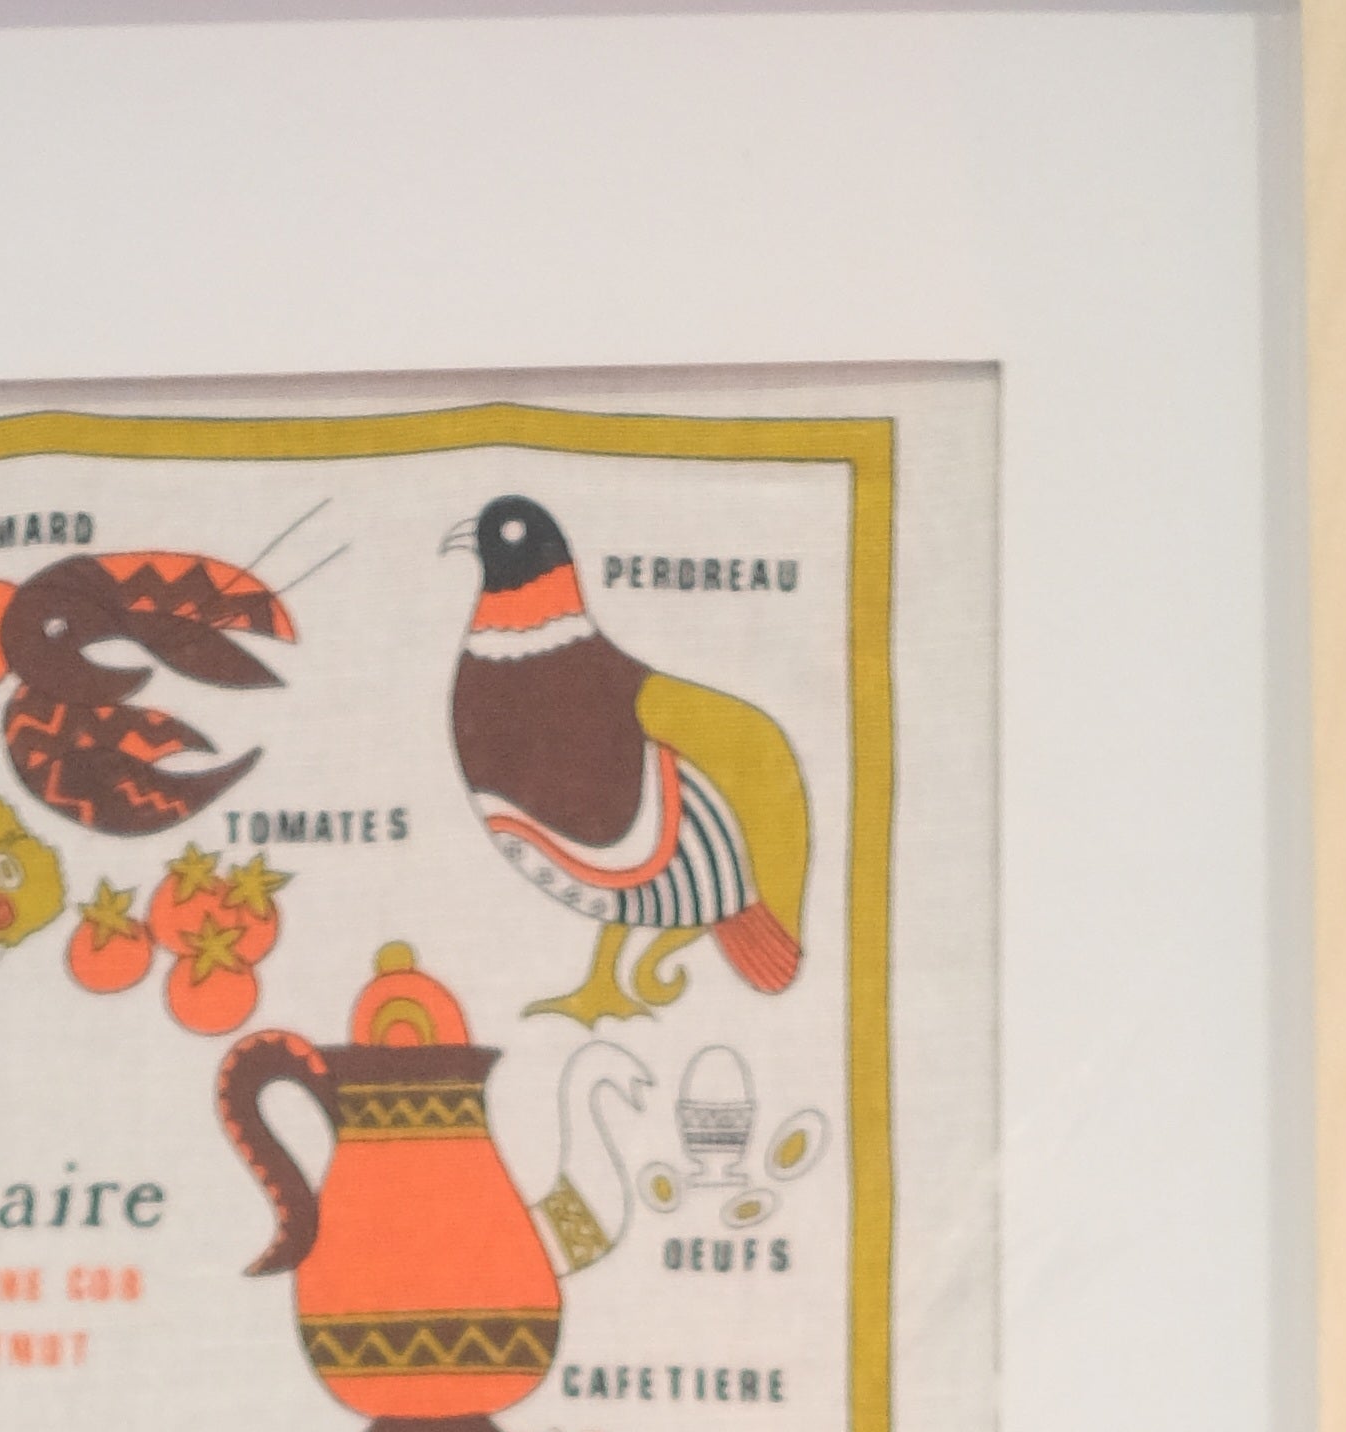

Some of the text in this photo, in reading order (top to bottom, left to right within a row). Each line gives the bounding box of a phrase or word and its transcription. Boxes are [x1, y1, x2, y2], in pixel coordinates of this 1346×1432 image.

[603, 555, 798, 593] PERDREAU
[227, 807, 409, 845] TOMATES
[663, 1237, 791, 1273] OEUFS
[563, 1364, 783, 1403] CAFETIERE
